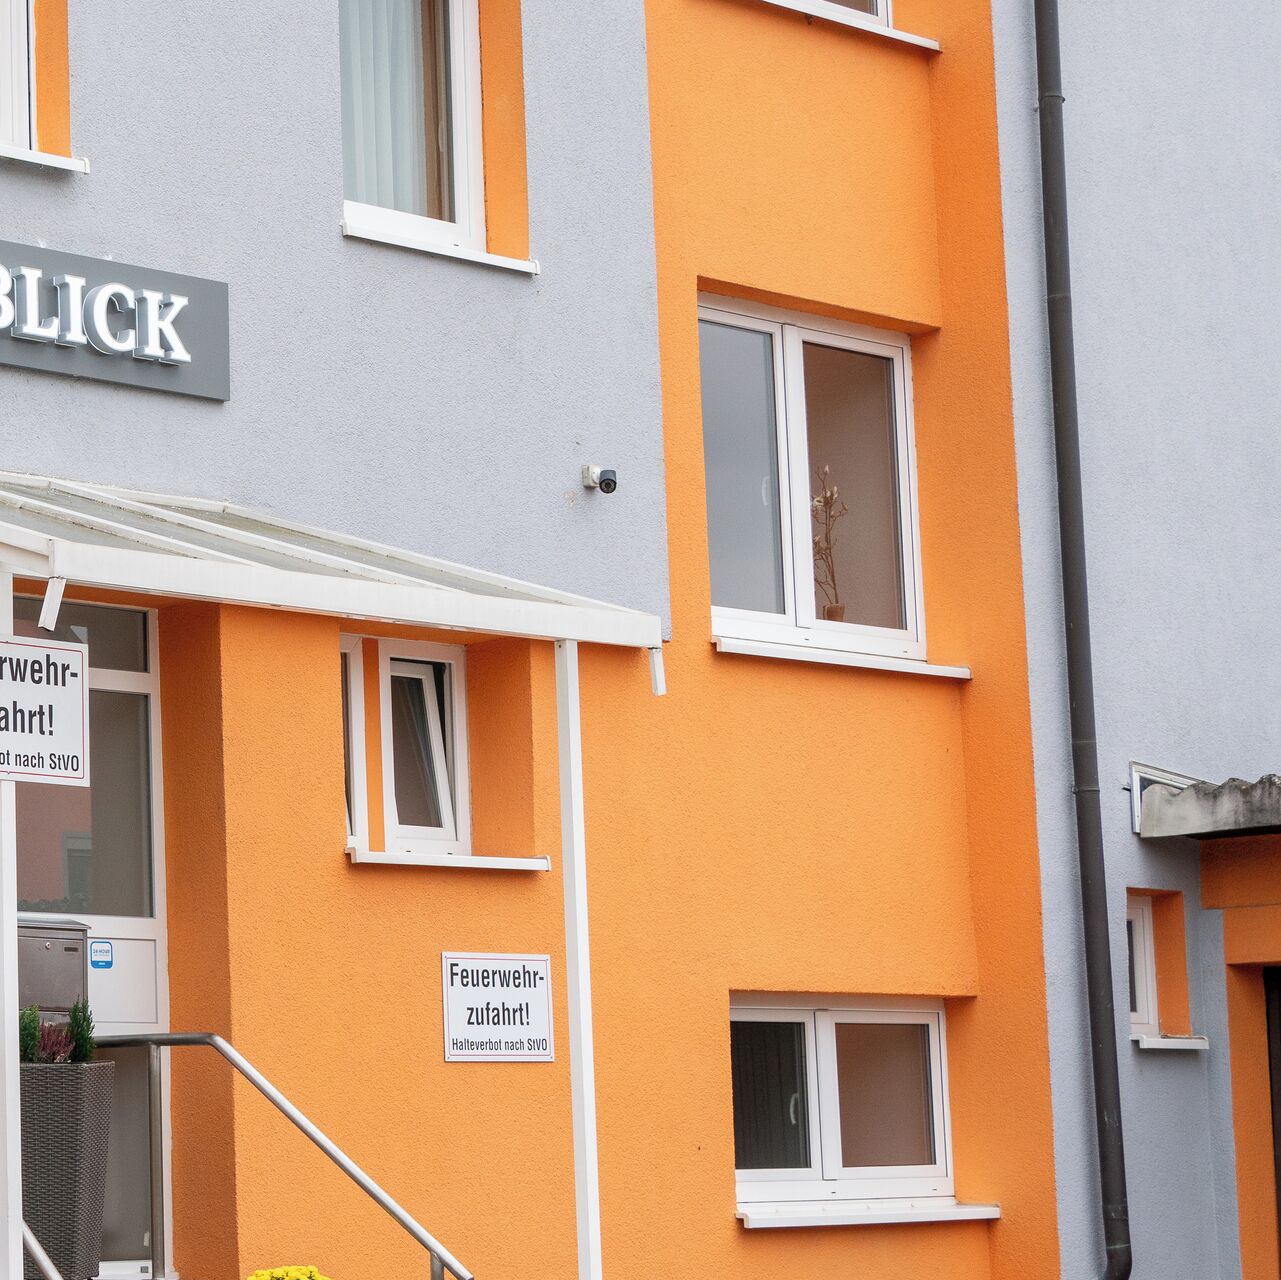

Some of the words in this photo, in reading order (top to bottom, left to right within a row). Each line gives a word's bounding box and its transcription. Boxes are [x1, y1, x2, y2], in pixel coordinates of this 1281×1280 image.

[15, 752, 44, 769] nach
[49, 753, 79, 771] StVO
[450, 963, 544, 988] Feuerwehr-
[466, 1001, 530, 1026] zufahrt!
[452, 1038, 502, 1051] Halteverbot
[504, 1038, 525, 1051] nach
[527, 1038, 548, 1051] StVO
